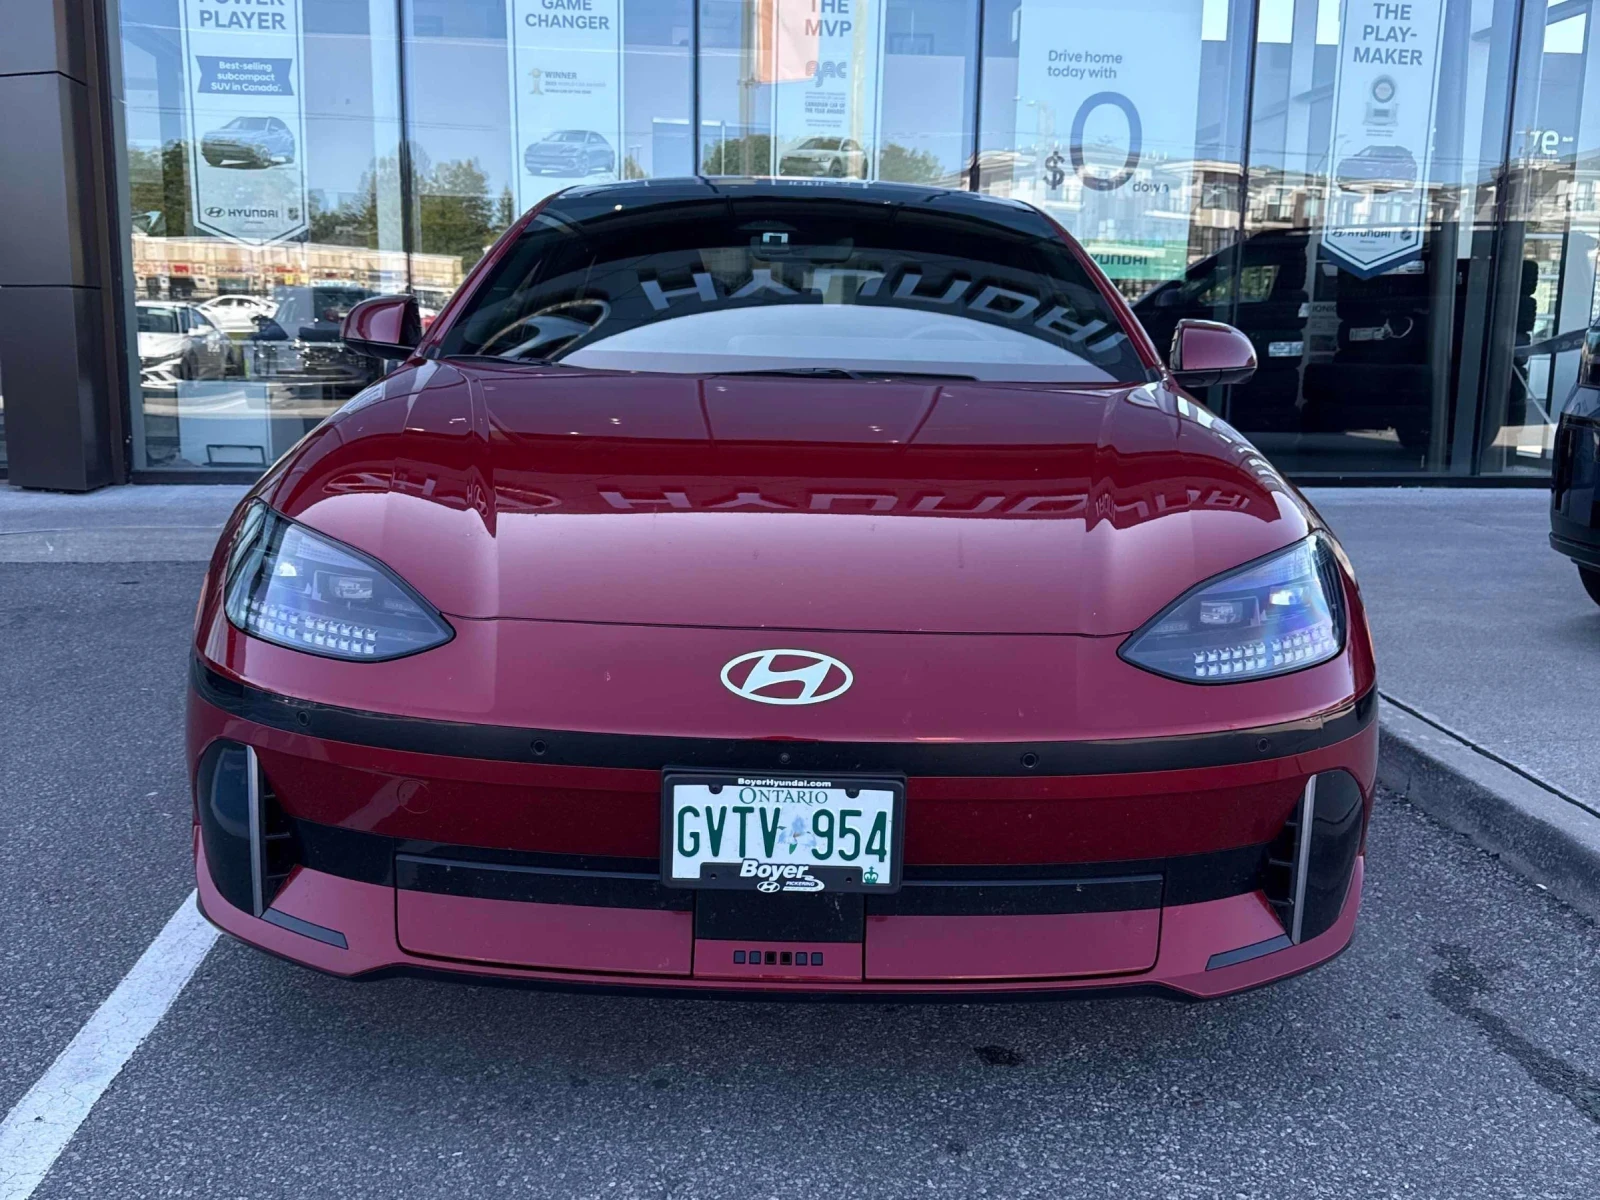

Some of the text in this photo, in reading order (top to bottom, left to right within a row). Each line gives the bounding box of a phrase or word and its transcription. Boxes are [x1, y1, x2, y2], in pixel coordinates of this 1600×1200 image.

[542, 0, 592, 11] GAME
[809, 0, 849, 14] THE
[1373, 3, 1412, 20] THE
[199, 9, 287, 30] PLAYER
[525, 13, 610, 30] CHANGER
[804, 19, 852, 37] MVP
[1362, 25, 1418, 43] PLAY-
[1048, 49, 1122, 64] Drive home
[1353, 46, 1423, 66] MAKER
[219, 61, 272, 72] Best-selling
[1047, 65, 1117, 80] today with
[217, 72, 275, 83] subcompact
[545, 71, 577, 80] WINNER
[211, 82, 230, 91] SUV
[232, 82, 240, 91] in
[1132, 181, 1170, 193] down
[228, 208, 279, 218] HYUNDAI
[1091, 253, 1148, 265] YUNDAI
[737, 778, 831, 787] BoyerHyundai.com
[739, 787, 828, 806] ONTARIO
[677, 805, 887, 862] GVTV 954
[739, 859, 809, 881] Boyer
